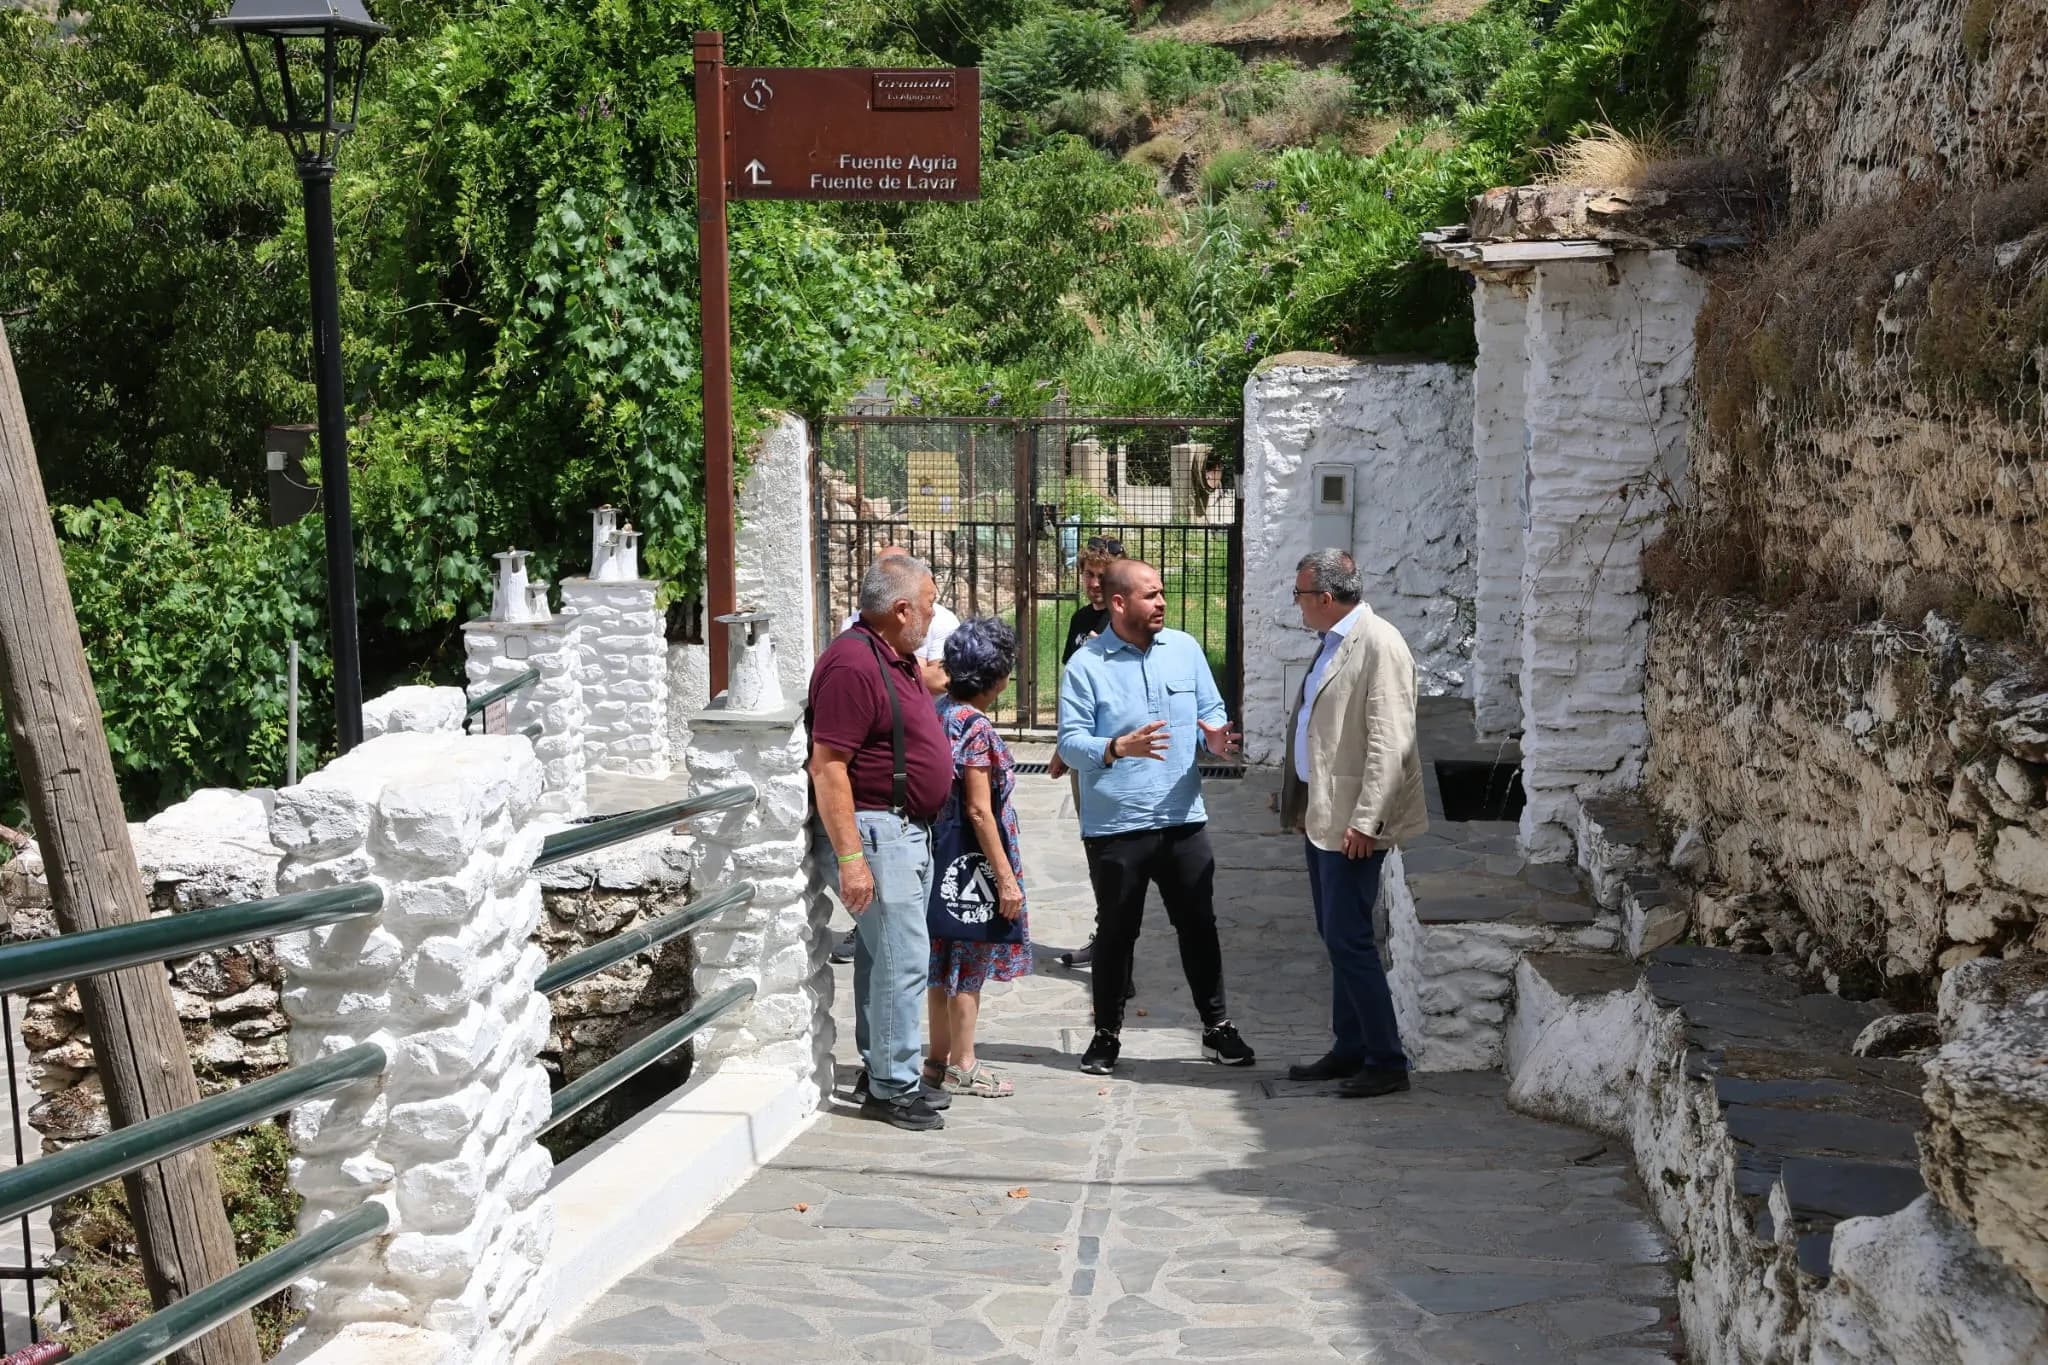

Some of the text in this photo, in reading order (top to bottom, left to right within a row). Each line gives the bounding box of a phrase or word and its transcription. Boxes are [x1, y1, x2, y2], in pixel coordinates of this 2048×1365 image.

[878, 78, 951, 88] Granada
[839, 154, 958, 173] Fuente Agria
[810, 174, 958, 190] Fuente de Lavar
